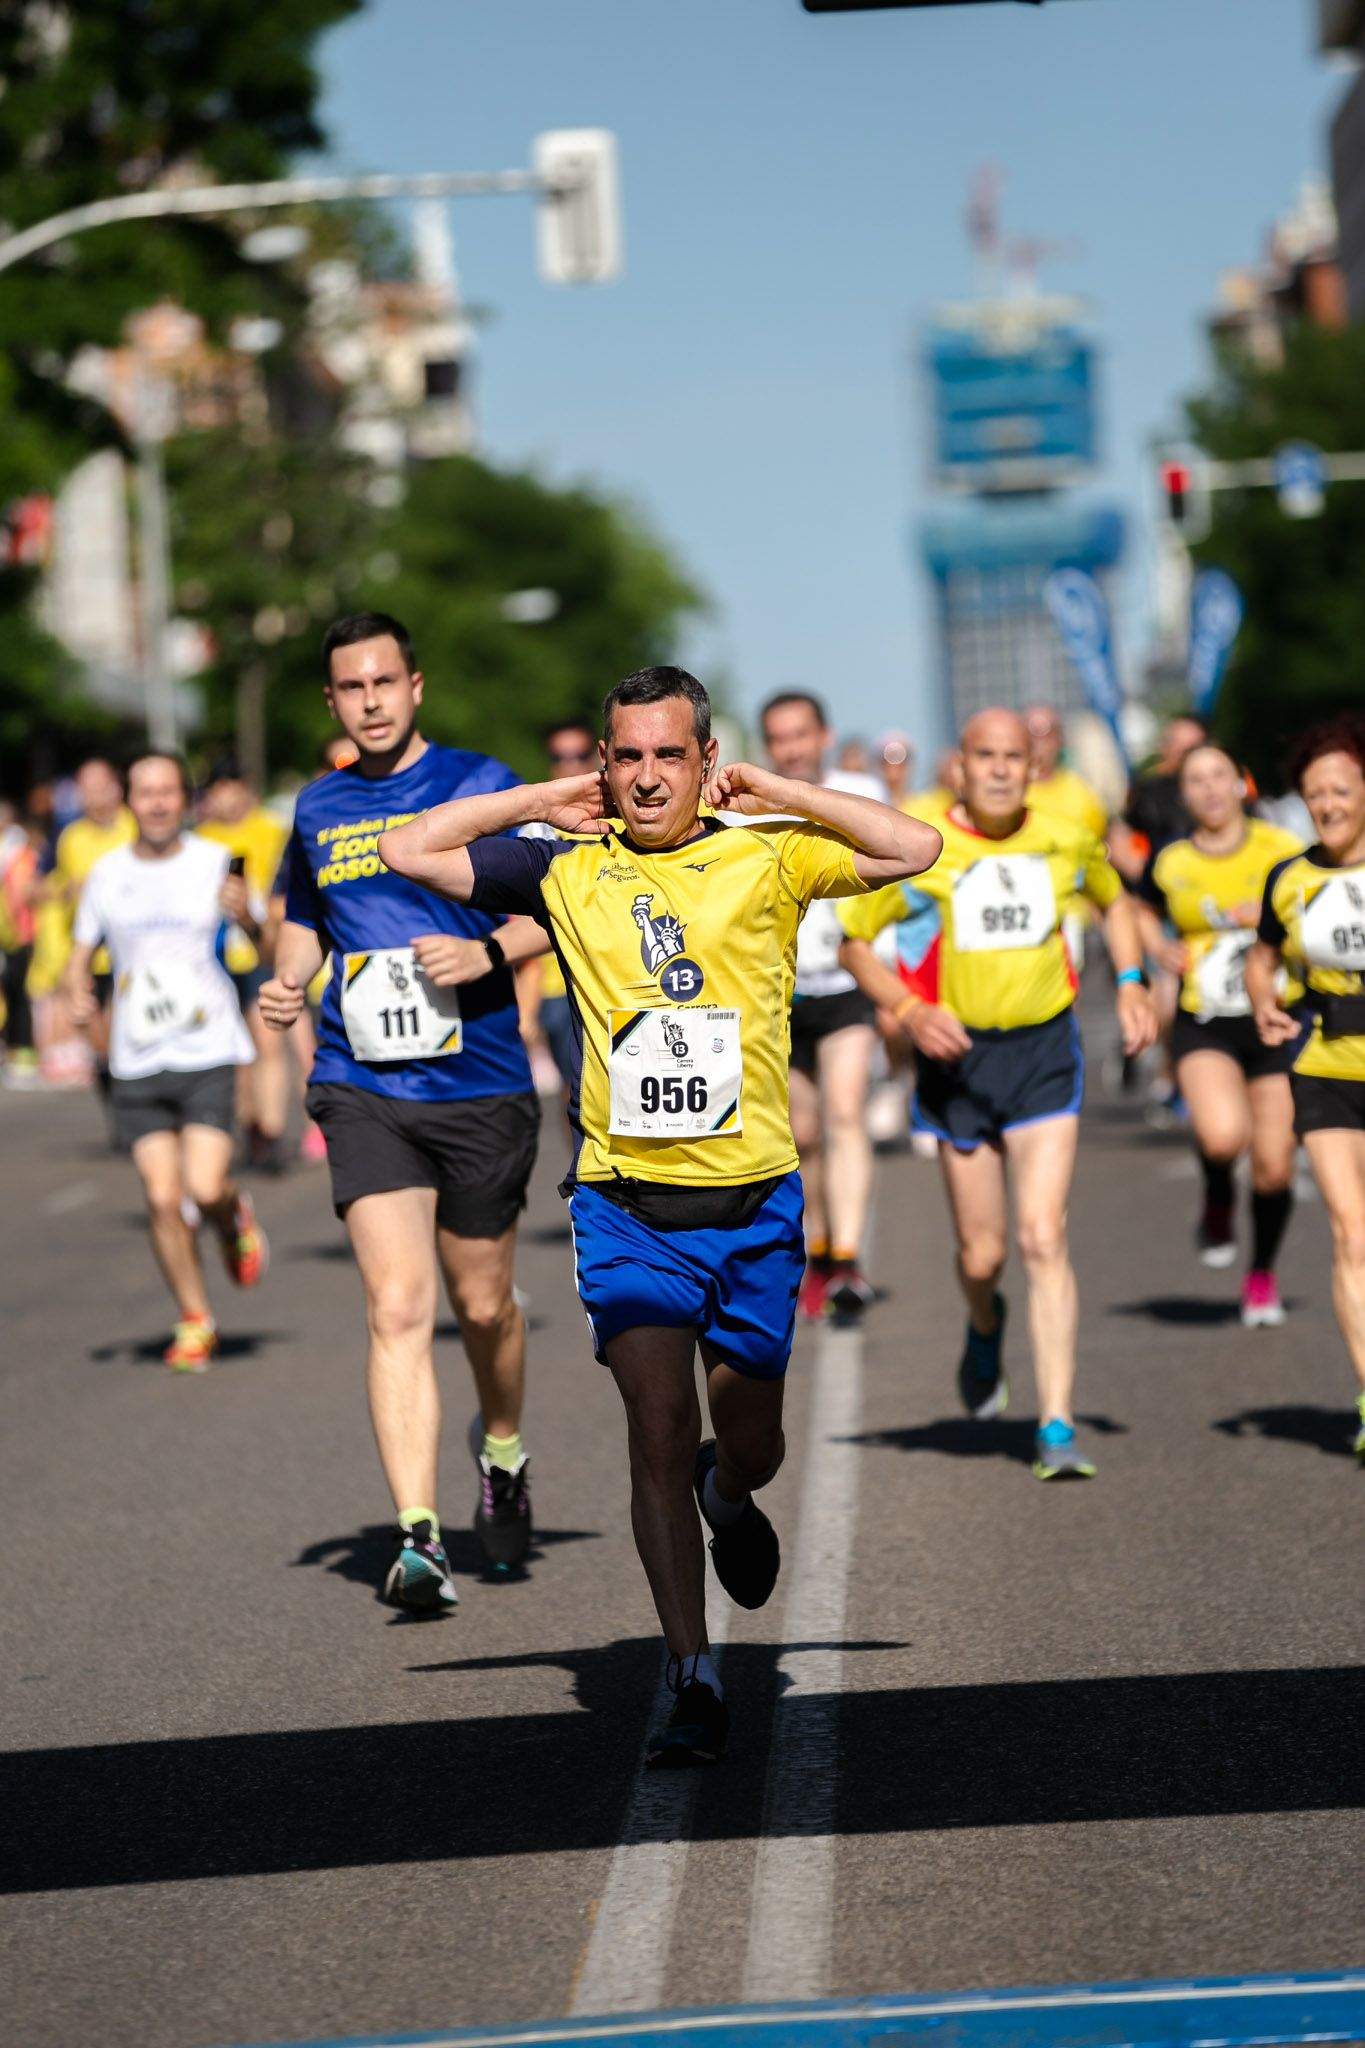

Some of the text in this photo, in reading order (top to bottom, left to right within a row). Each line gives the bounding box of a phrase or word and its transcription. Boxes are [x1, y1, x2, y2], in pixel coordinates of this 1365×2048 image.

[982, 902, 1031, 933] 992
[669, 968, 694, 992] 13
[379, 1007, 421, 1038] 111
[674, 1044, 686, 1055] 13
[640, 1076, 708, 1114] 956
